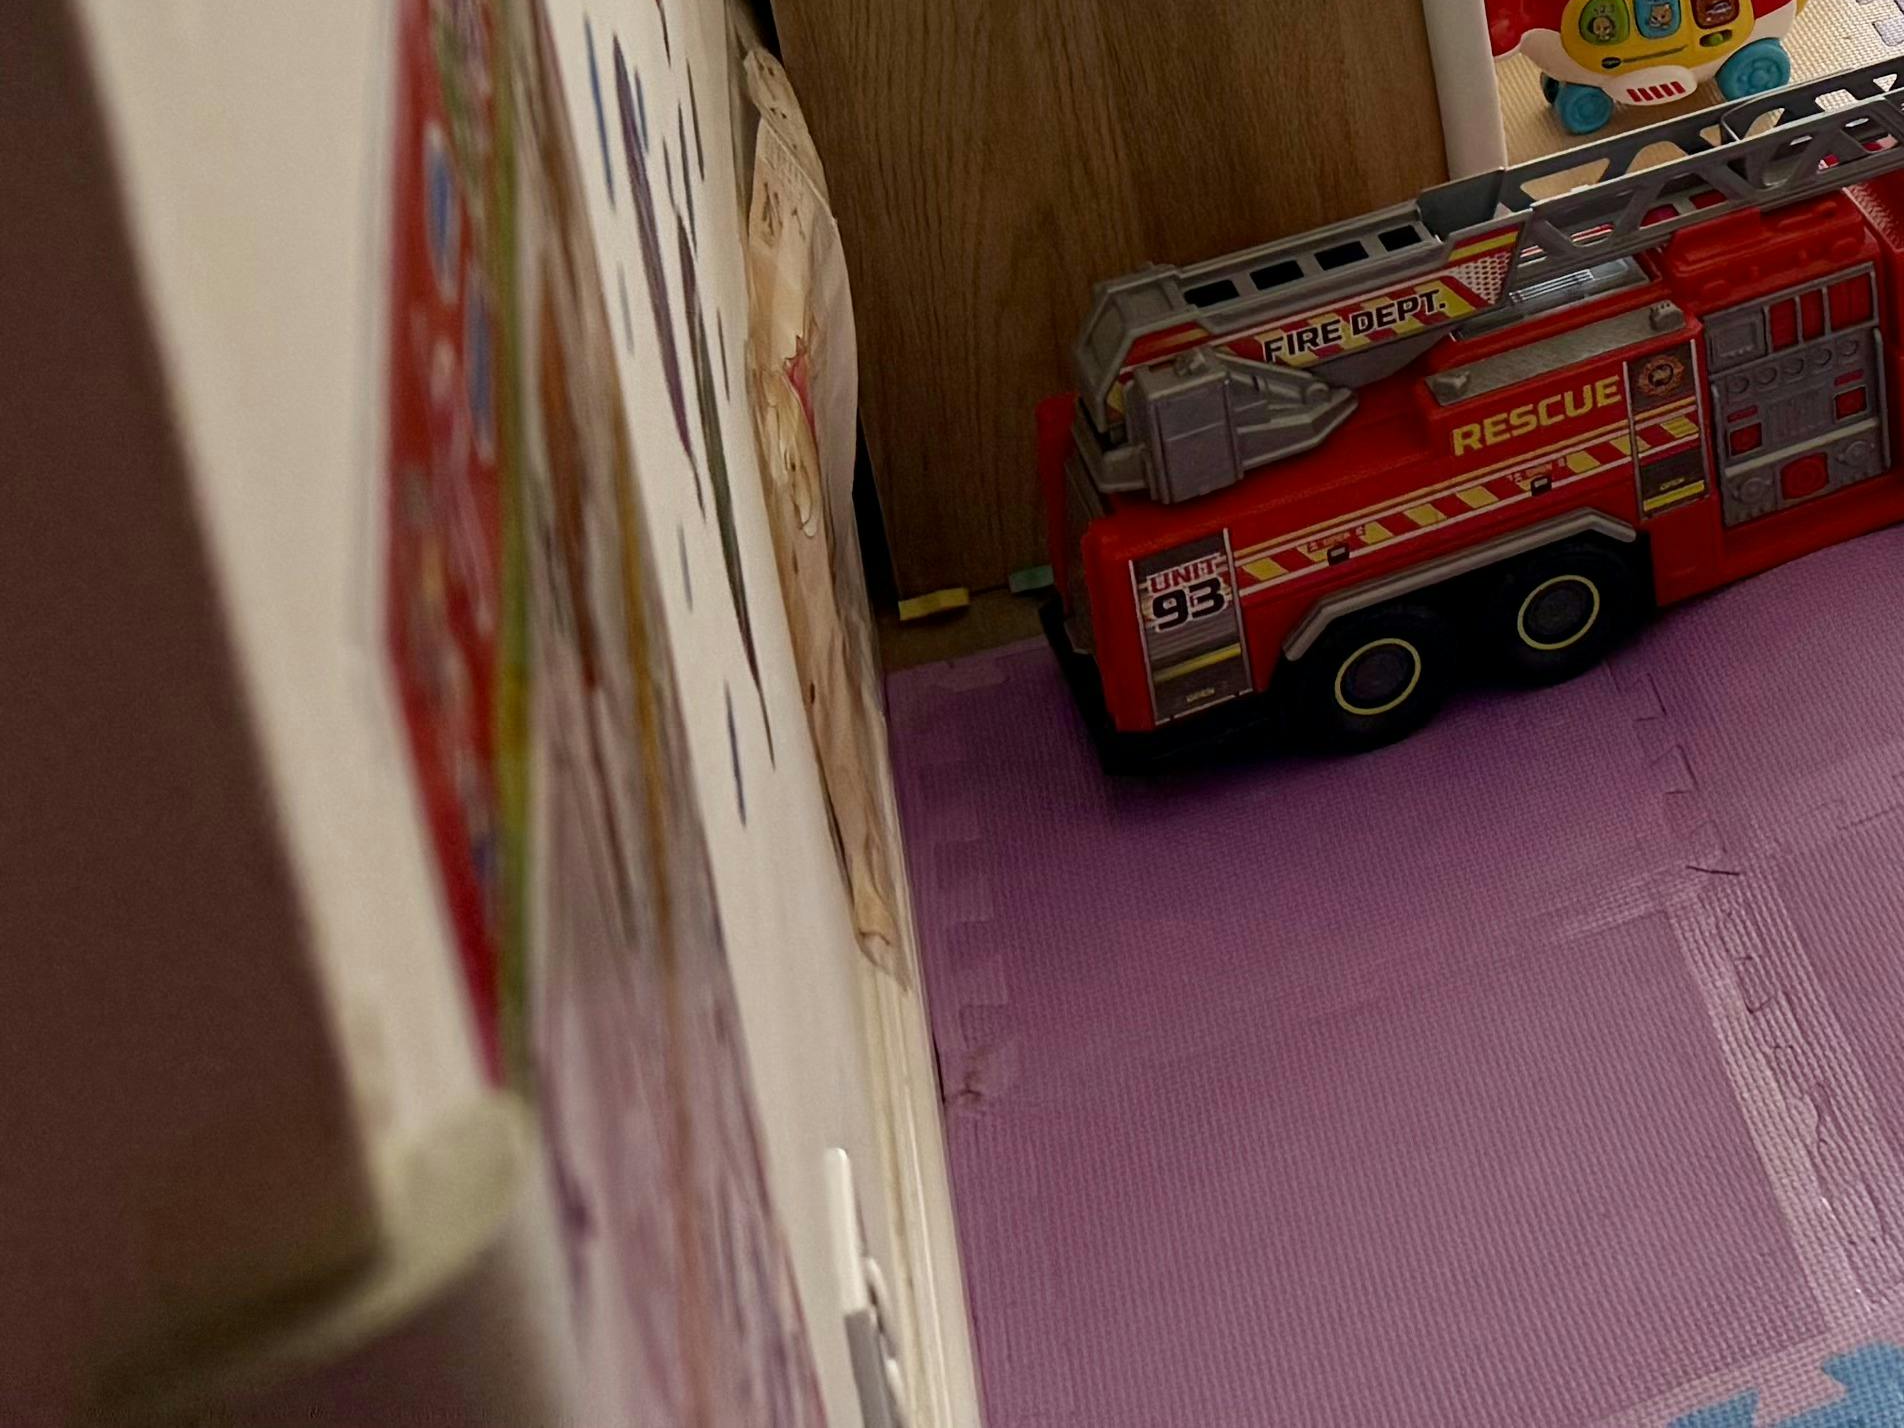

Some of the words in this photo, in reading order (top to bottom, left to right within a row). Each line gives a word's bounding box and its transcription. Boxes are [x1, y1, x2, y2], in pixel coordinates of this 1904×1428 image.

[1263, 319, 1342, 362] FIRE
[1352, 289, 1447, 336] DEPT.
[1451, 375, 1622, 457] RESCUE
[1150, 558, 1217, 593] UNIT
[1152, 577, 1226, 631] 93
